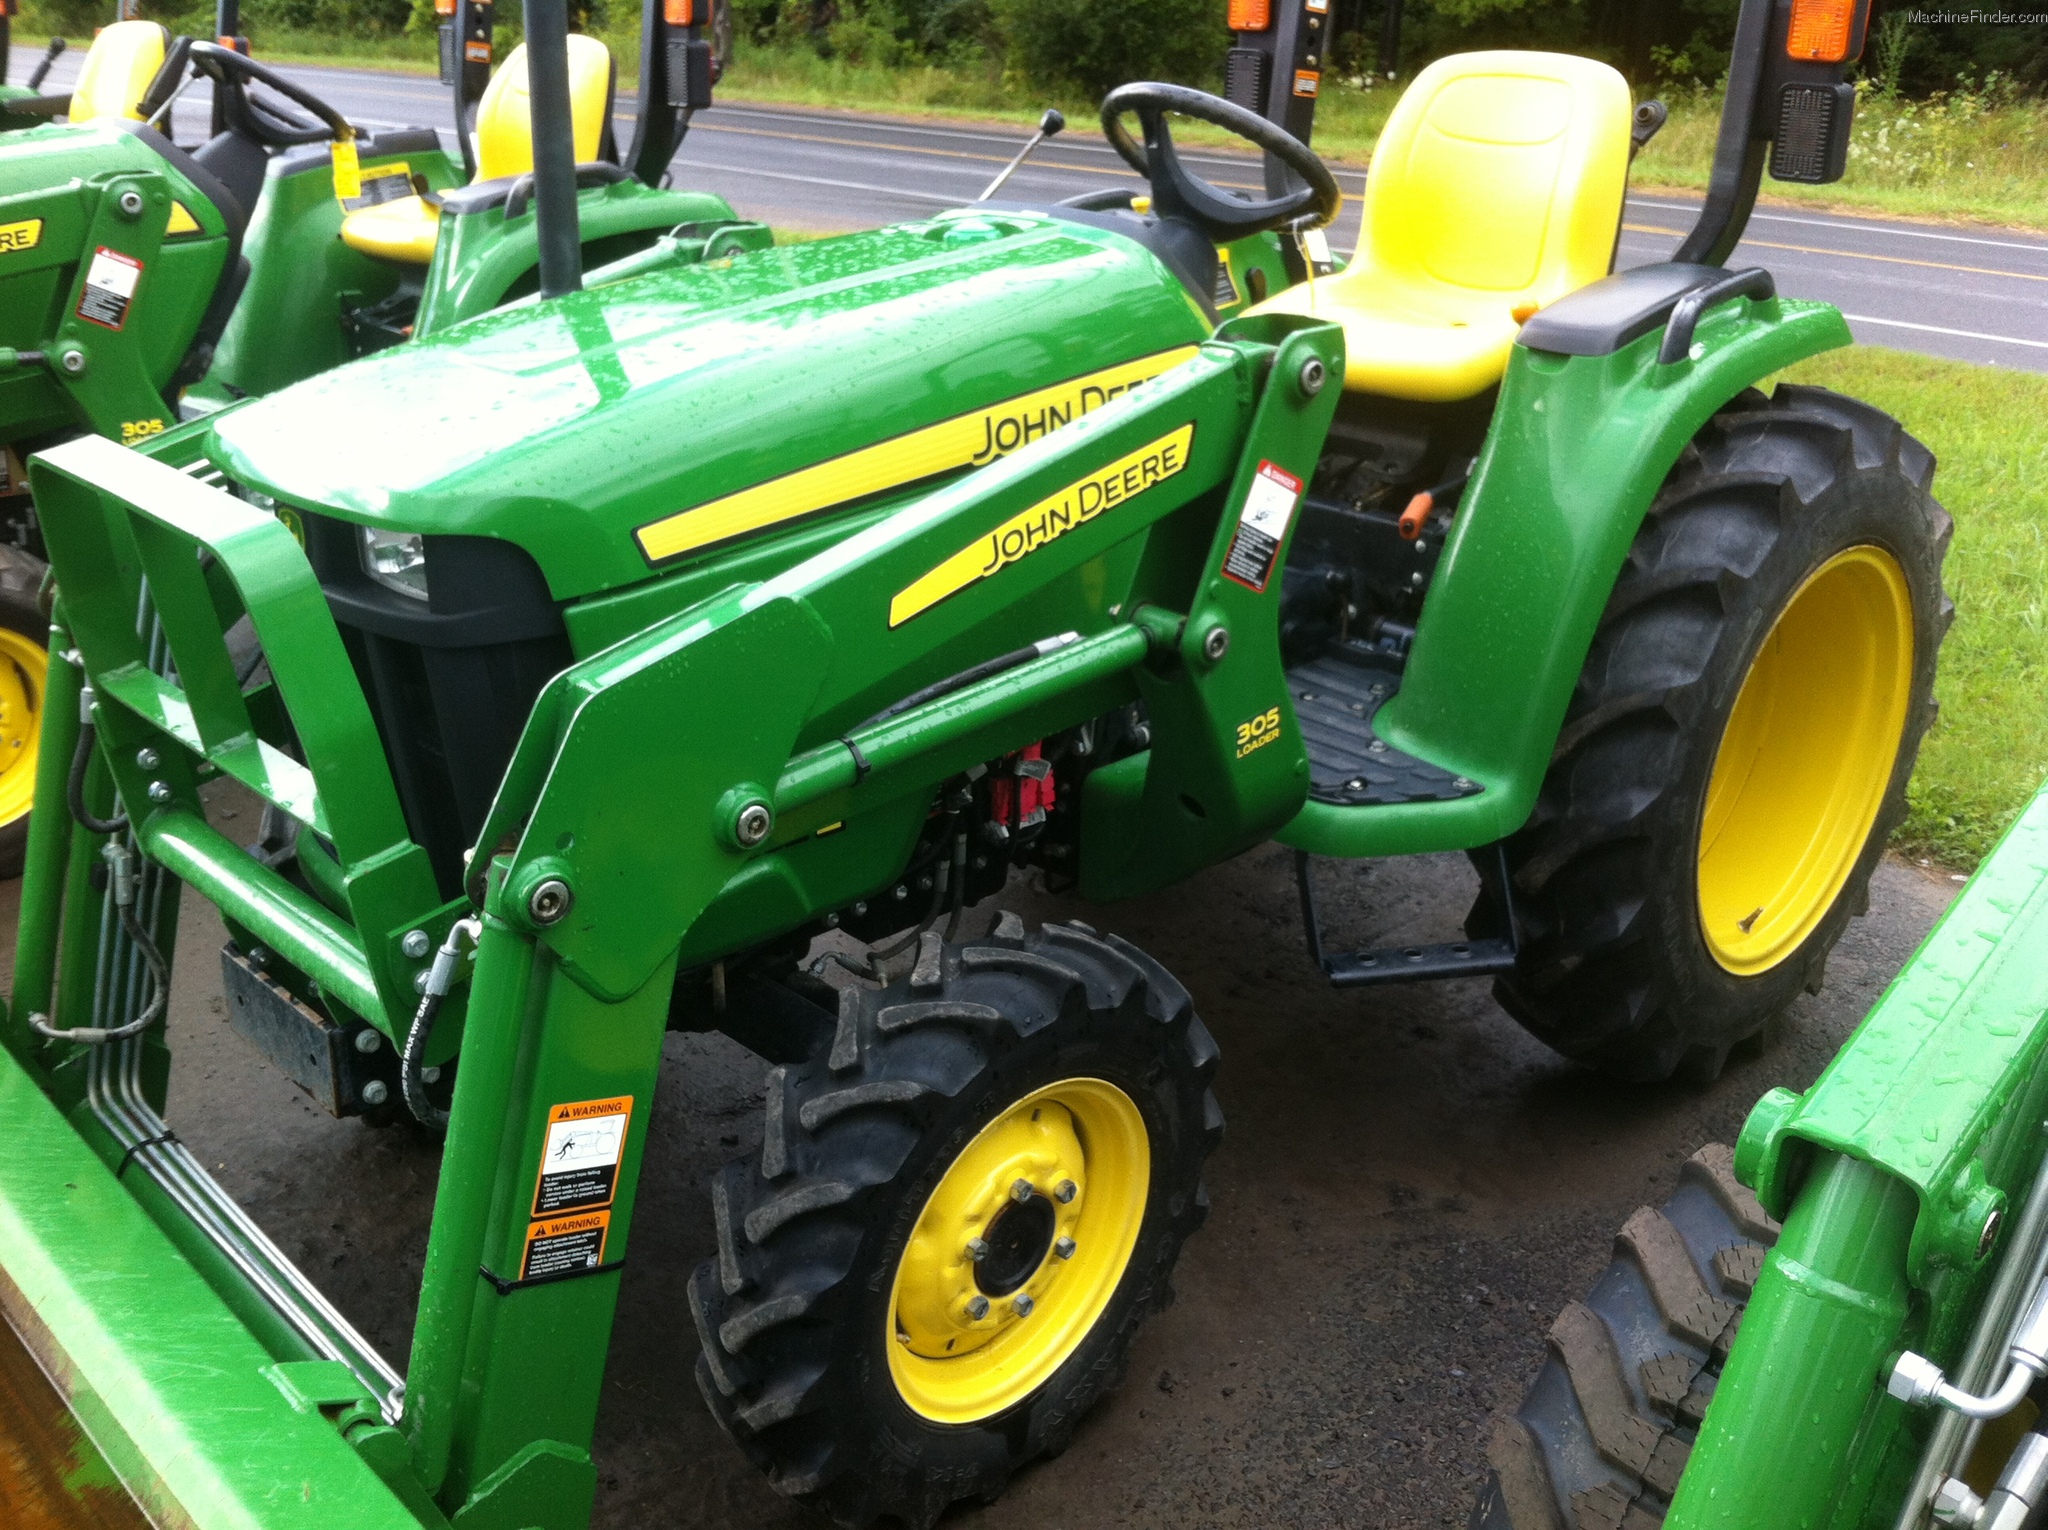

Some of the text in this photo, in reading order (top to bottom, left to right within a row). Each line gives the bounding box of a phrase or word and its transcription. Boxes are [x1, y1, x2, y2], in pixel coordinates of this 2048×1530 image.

[121, 418, 164, 437] 305
[973, 401, 1071, 461] JOHN
[983, 444, 1179, 572] JOHN DEERE
[1236, 706, 1279, 745] 305
[1236, 728, 1280, 759] LOADER
[403, 1036, 415, 1060] MAX
[410, 1017, 420, 1035] WP
[417, 995, 431, 1018] SAE
[572, 1102, 622, 1117] WARNING
[551, 1217, 600, 1232] WARNING
